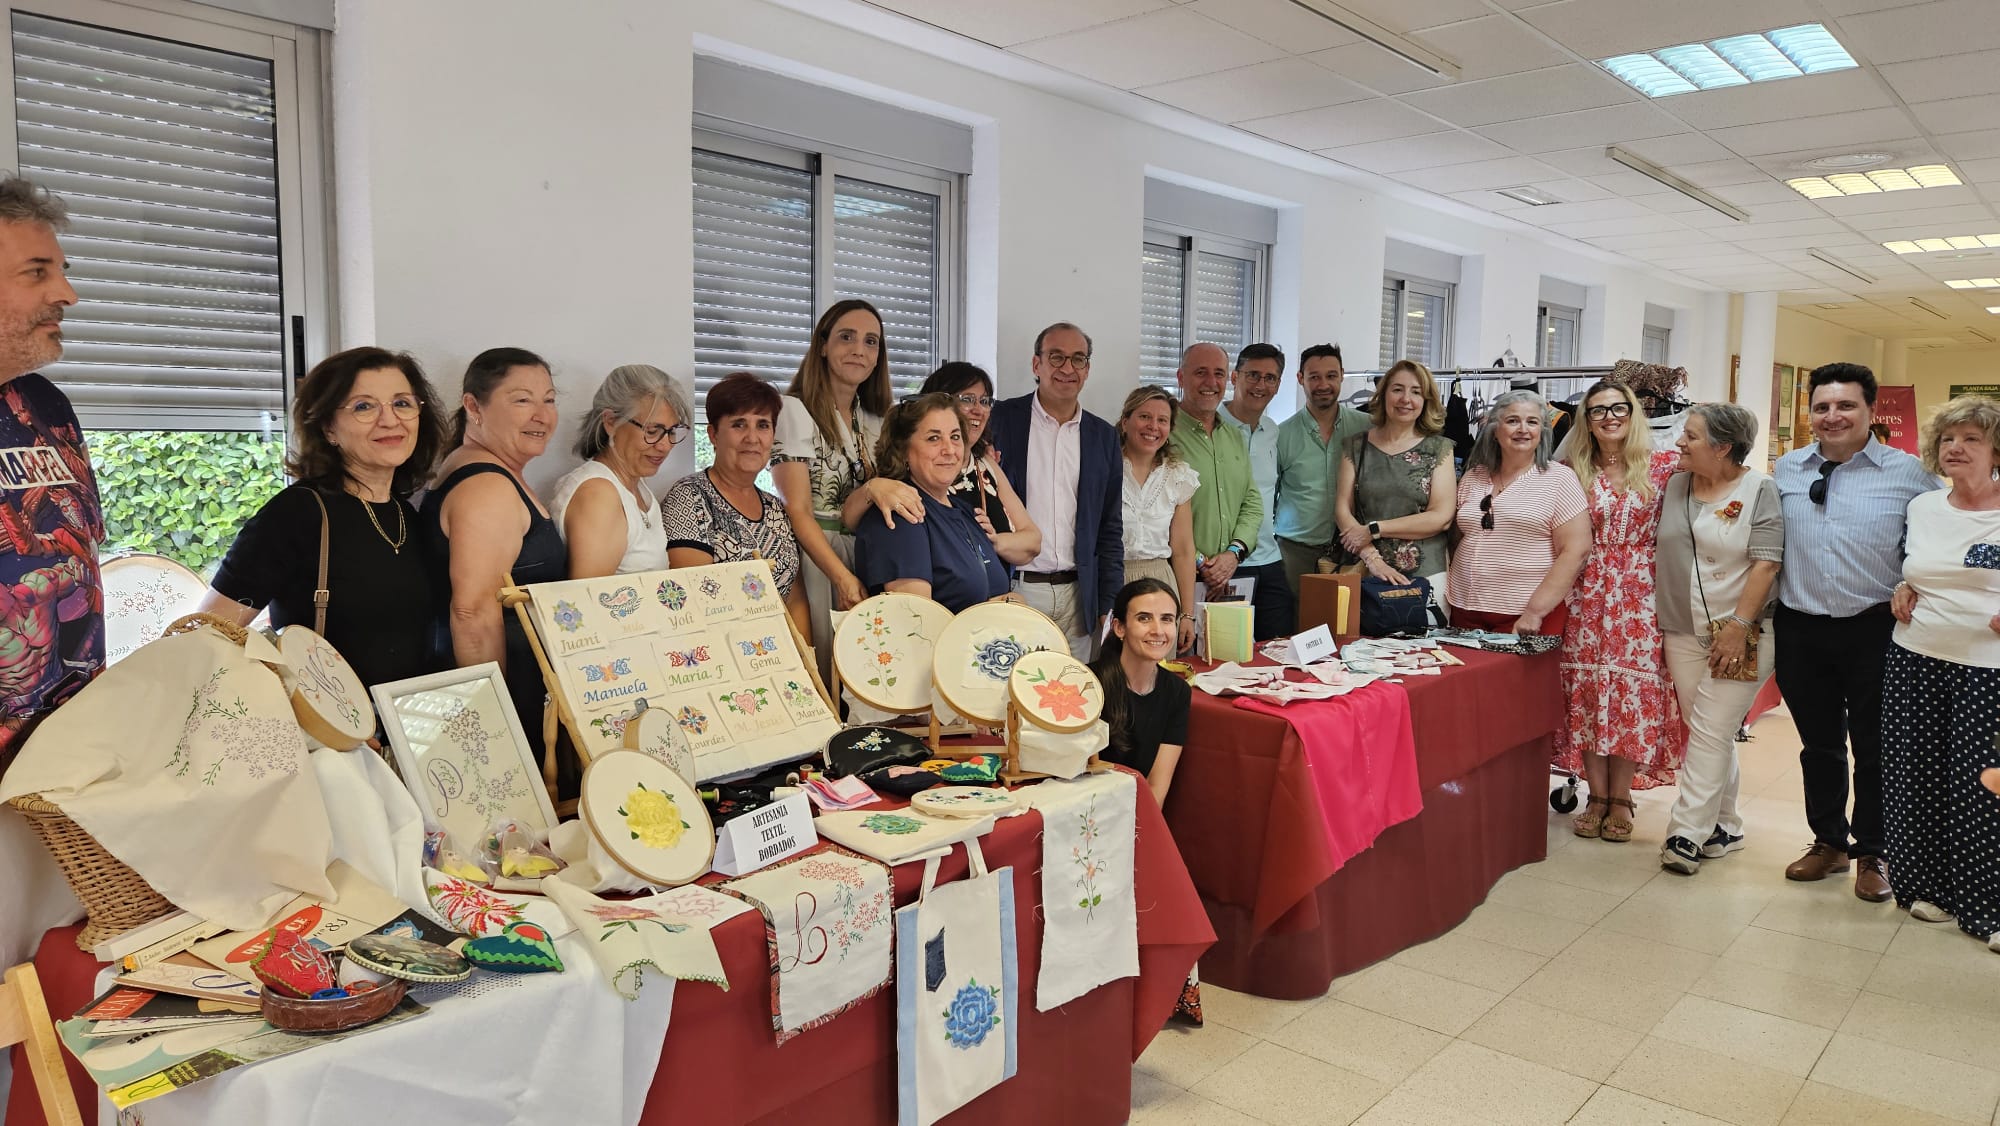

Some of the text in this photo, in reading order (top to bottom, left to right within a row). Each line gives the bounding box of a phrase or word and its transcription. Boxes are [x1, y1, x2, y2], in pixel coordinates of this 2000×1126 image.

[1870, 415, 1902, 425] ceres
[705, 604, 735, 617] Laura
[668, 612, 695, 630] Yoli
[560, 632, 601, 654] Juani
[749, 656, 782, 672] Gema
[583, 678, 649, 705] Manuela
[751, 804, 789, 829] ARTESANÍA
[760, 823, 788, 843] TEXTIL:
[758, 835, 797, 862] BORDADOS
